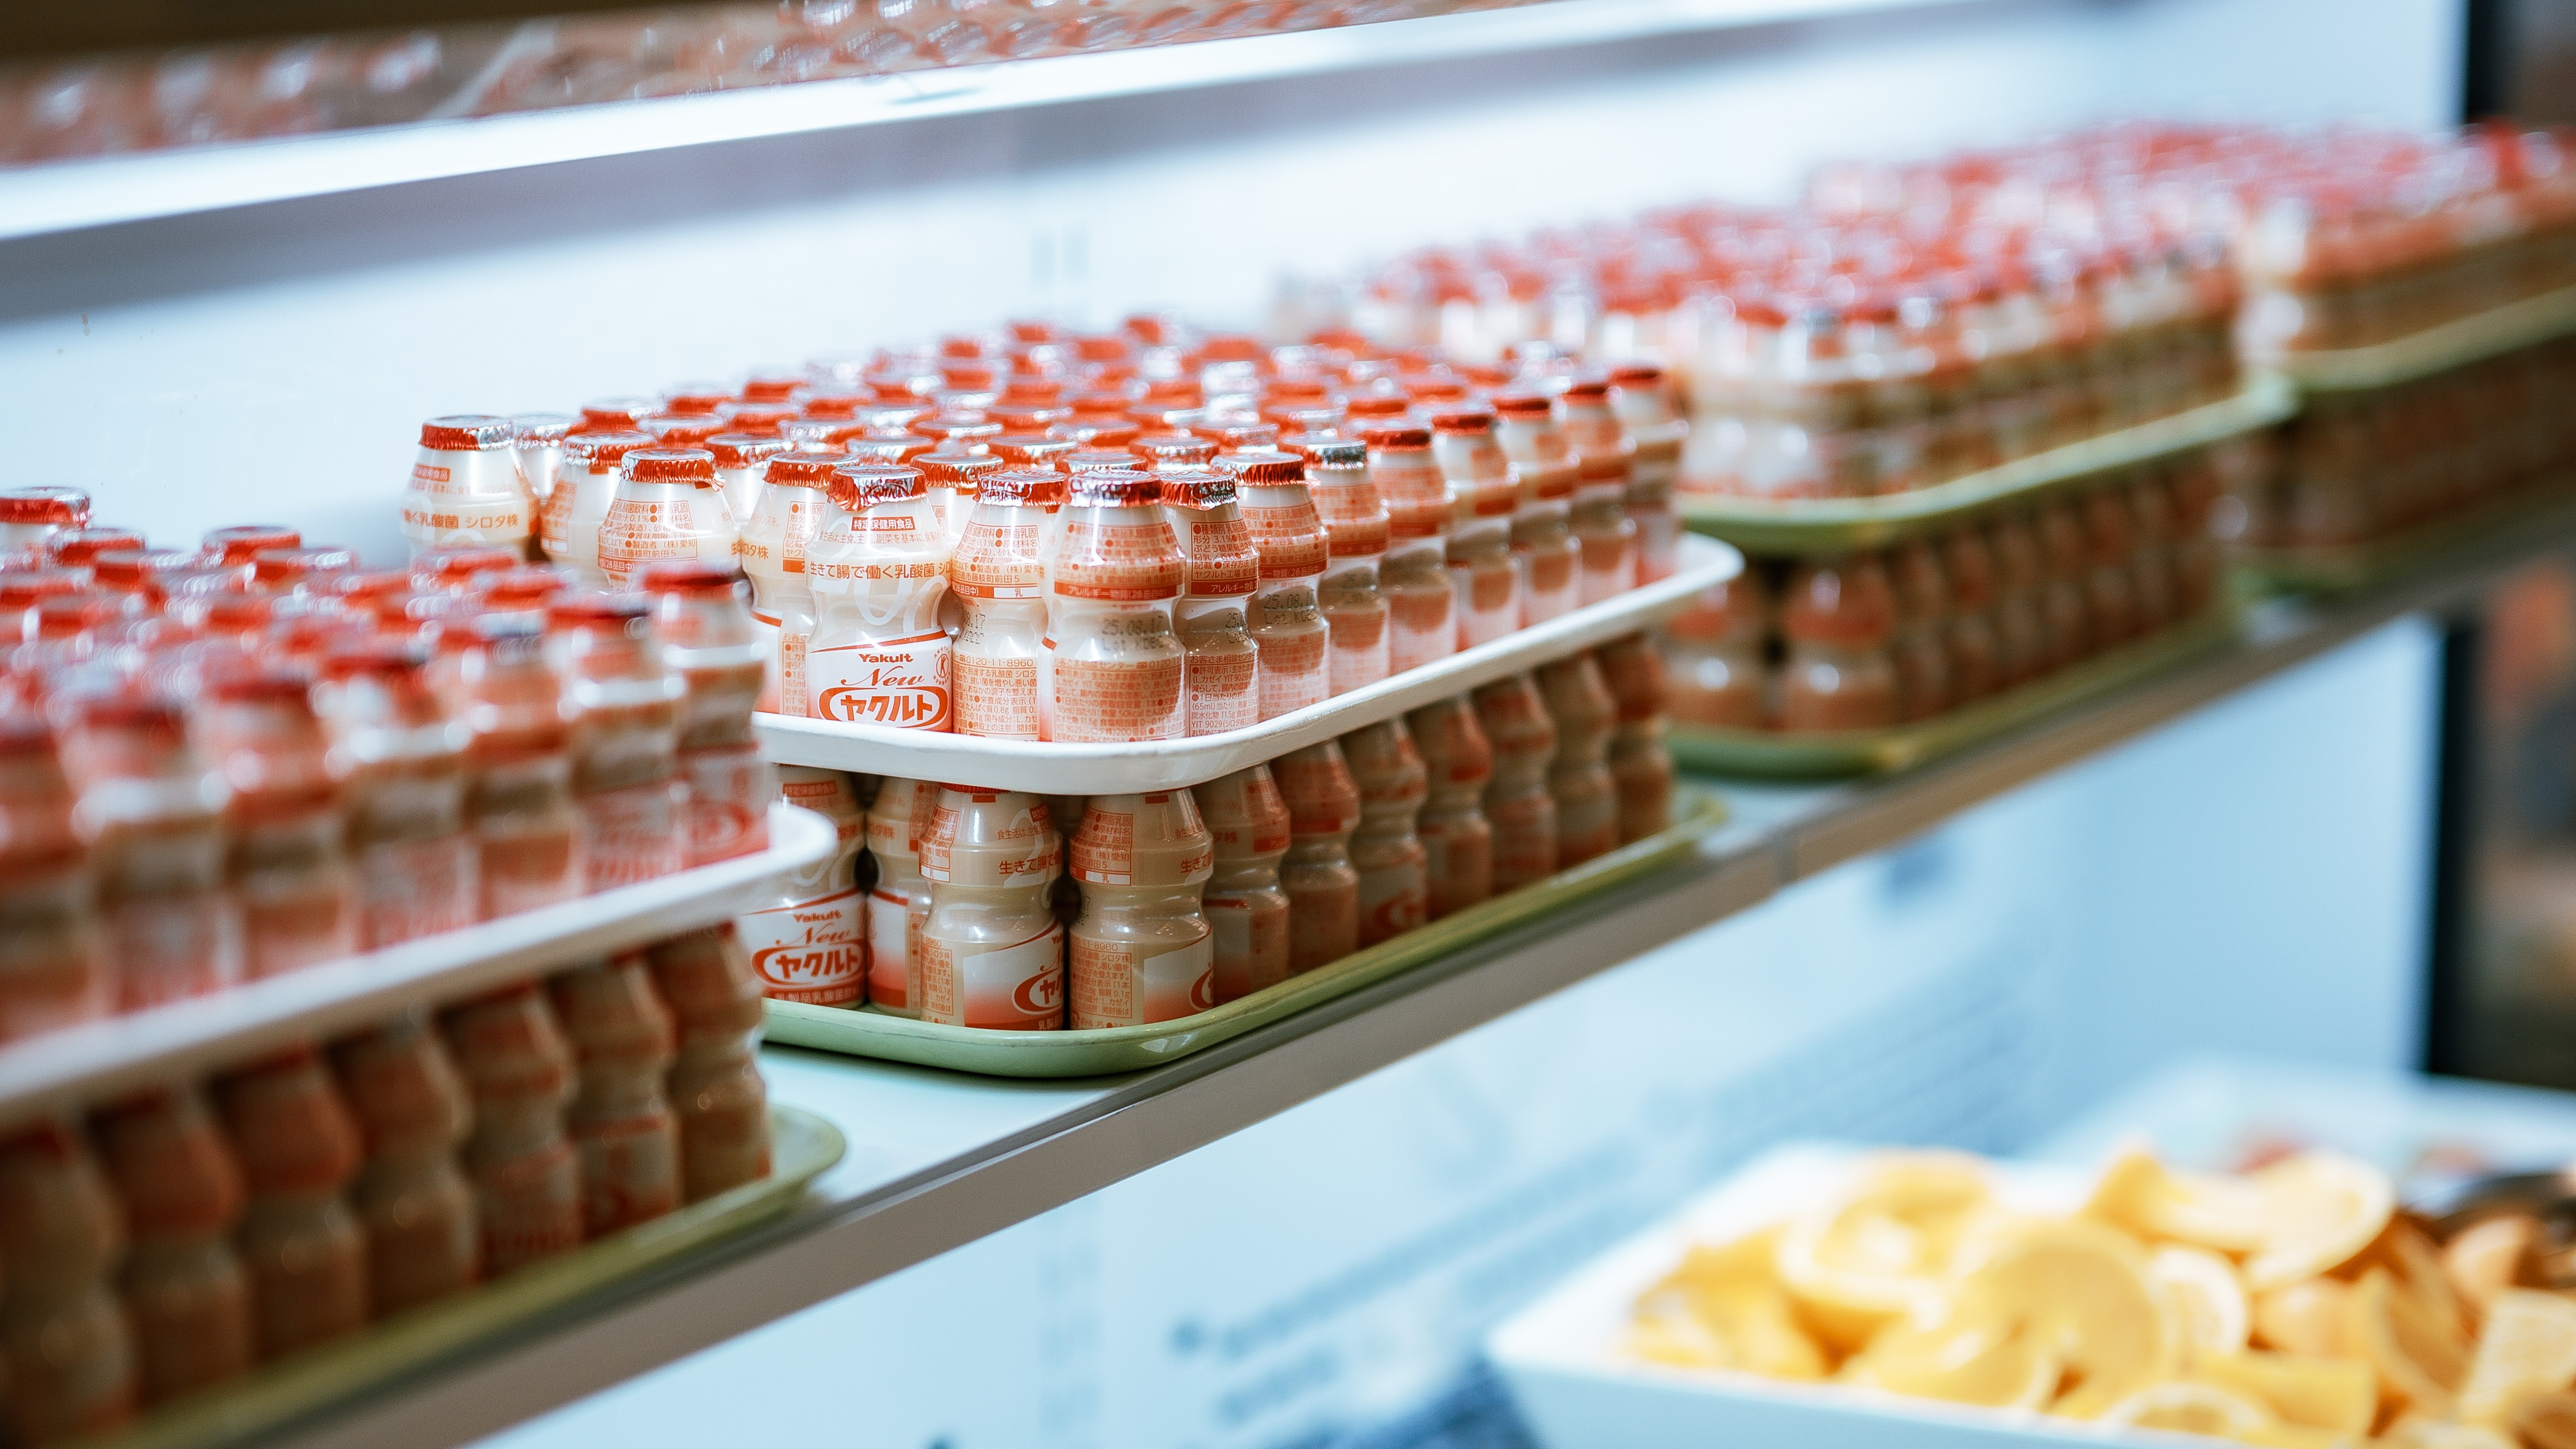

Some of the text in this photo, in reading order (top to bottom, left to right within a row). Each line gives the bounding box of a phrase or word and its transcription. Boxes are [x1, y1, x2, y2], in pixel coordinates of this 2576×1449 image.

[466, 514, 518, 528] シロタ株
[1202, 524, 1225, 534] 種類別
[664, 539, 695, 549] (株)愛知
[1193, 536, 1210, 544] 形分
[810, 561, 935, 579] 生きて腸で働く乳酸菌
[977, 564, 1000, 574] 製造者
[1194, 559, 1249, 570] 記載 保存方法
[1194, 570, 1240, 578] ヤクルト工場
[952, 583, 978, 596] (28品目中)
[1015, 588, 1023, 597] 乳
[858, 654, 913, 663] Yakult
[966, 656, 1033, 667] 0120-11-8960
[1190, 653, 1255, 664] お客さま相談センター
[840, 666, 924, 686] New
[981, 696, 1026, 705] 栄養成分表示
[840, 694, 932, 722] ヤクルト
[1222, 710, 1235, 719] 11.5g
[1099, 825, 1130, 836] 原材料名
[1096, 851, 1129, 862] (株)愛知
[999, 851, 1060, 874] 生きて腸で
[1181, 851, 1212, 874] 生きて
[1102, 874, 1109, 883] 乳
[793, 910, 842, 922] Yakult
[776, 922, 850, 945] New
[931, 949, 950, 959] シロタ株
[1102, 955, 1129, 963] シロタ株
[776, 947, 858, 979] ヤクルト
[1114, 990, 1129, 999] 0.1g
